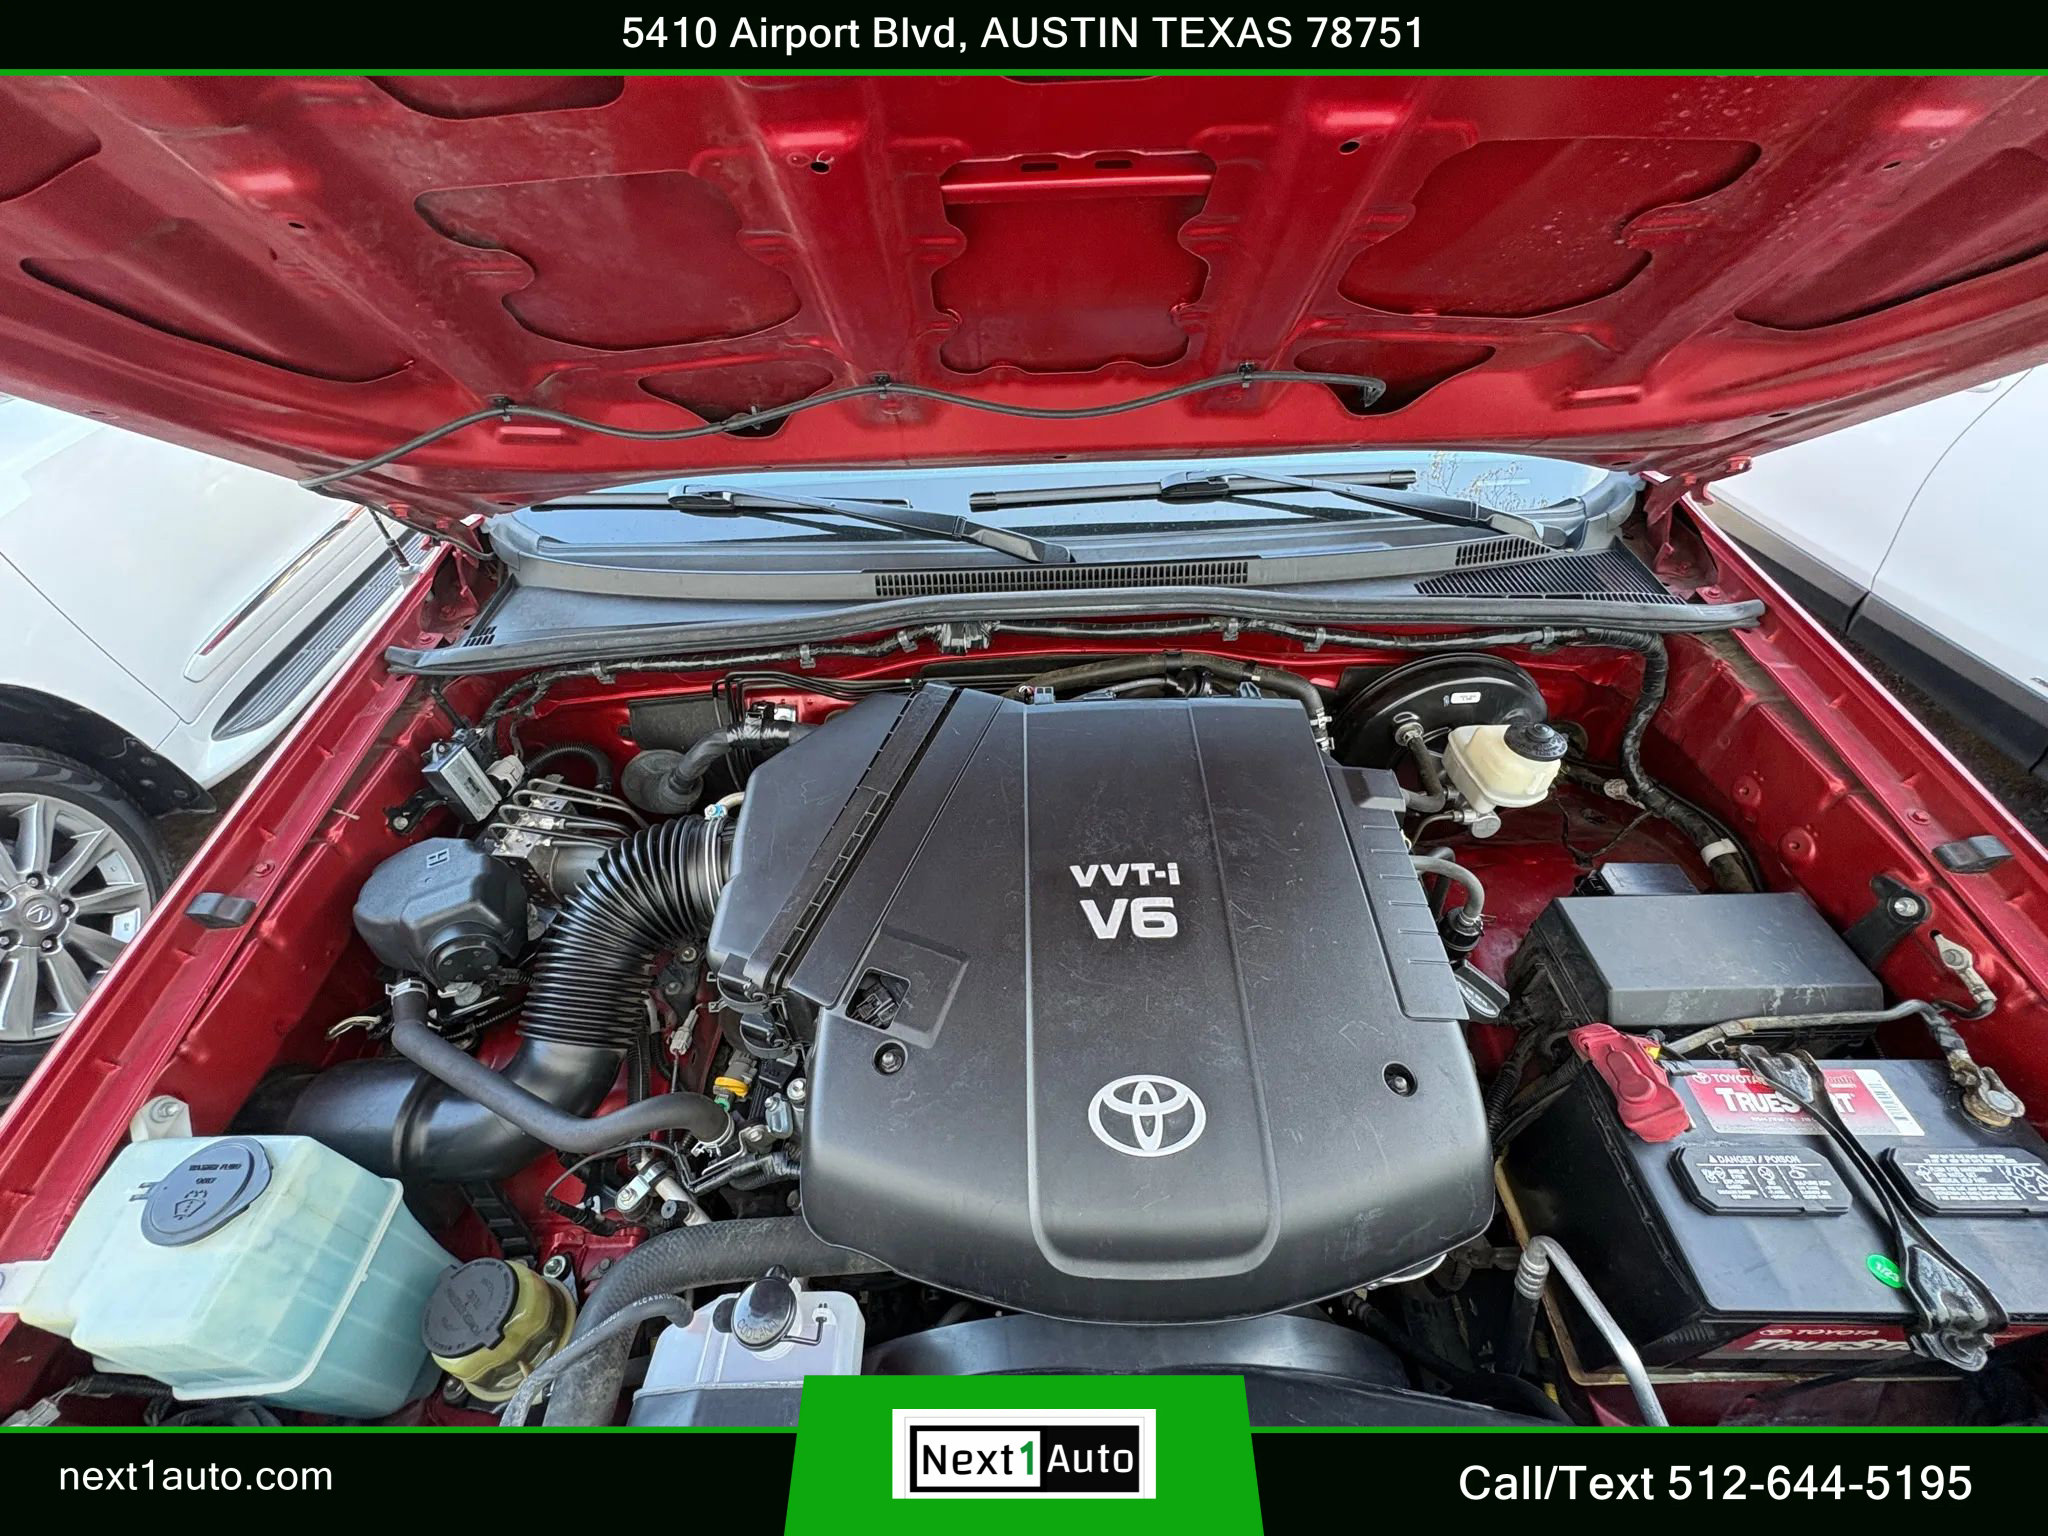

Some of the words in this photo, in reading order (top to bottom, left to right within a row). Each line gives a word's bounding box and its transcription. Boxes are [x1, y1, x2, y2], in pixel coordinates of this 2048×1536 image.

[1069, 862, 1181, 888] VVT-i
[1079, 896, 1179, 939] V6
[1714, 1087, 1856, 1114] TRUEST
[1717, 1155, 1757, 1164] DANGER
[1765, 1155, 1801, 1164] POISON
[1796, 1329, 1881, 1337] TOYOTA
